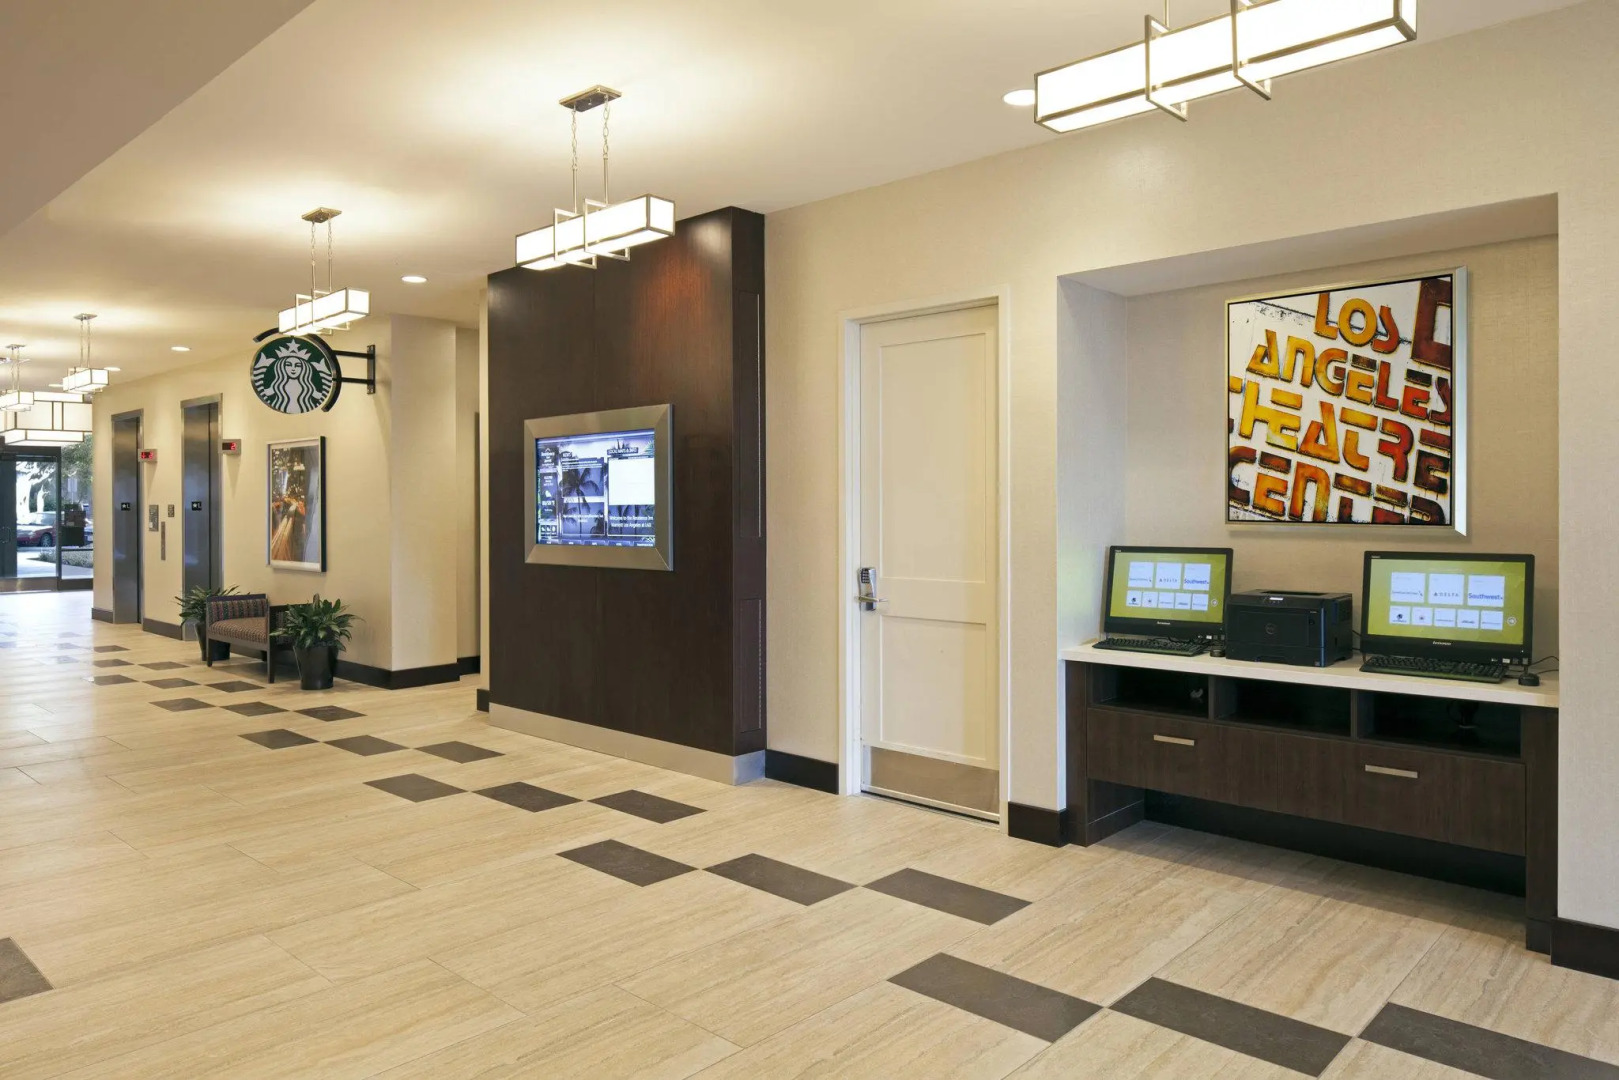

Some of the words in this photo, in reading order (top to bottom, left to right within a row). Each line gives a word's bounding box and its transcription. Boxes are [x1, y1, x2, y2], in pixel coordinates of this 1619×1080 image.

[1313, 292, 1400, 354] LOS
[230, 442, 236, 450] 2
[1228, 375, 1451, 495] HEATRE
